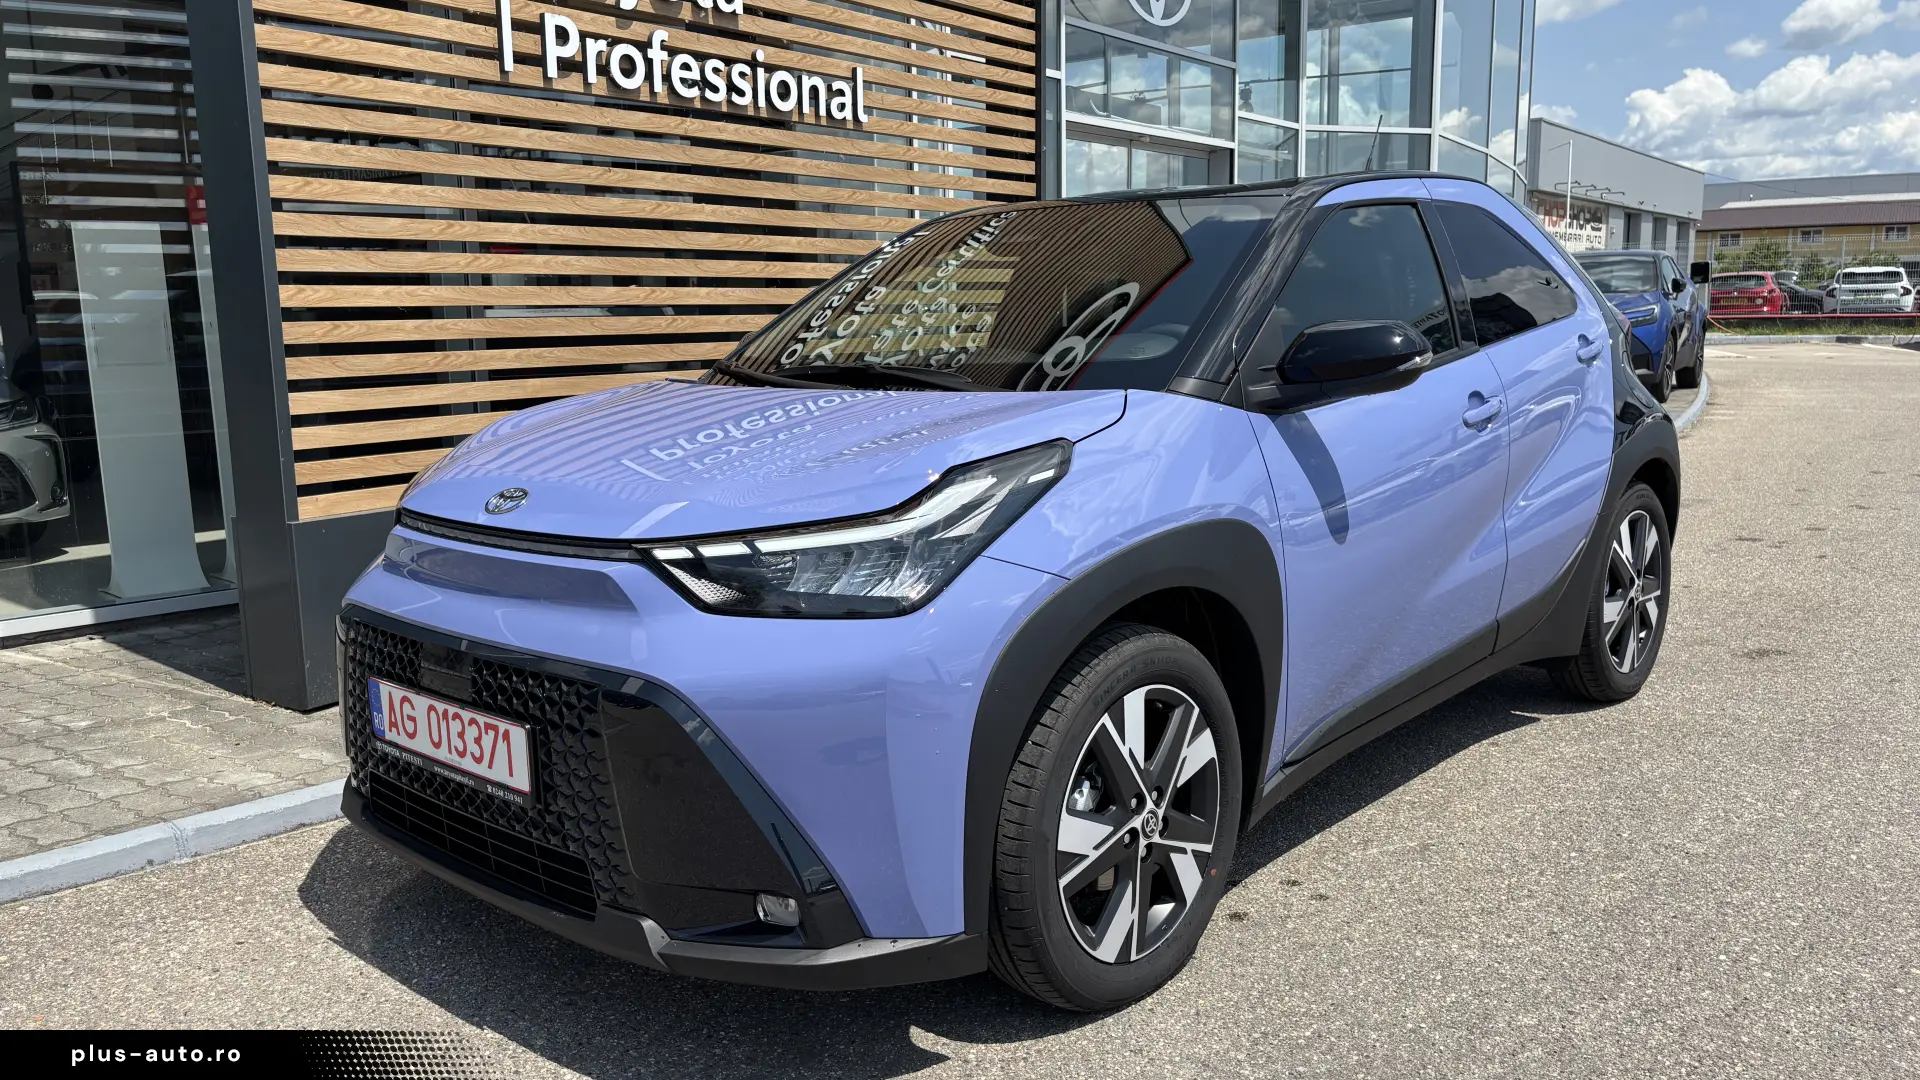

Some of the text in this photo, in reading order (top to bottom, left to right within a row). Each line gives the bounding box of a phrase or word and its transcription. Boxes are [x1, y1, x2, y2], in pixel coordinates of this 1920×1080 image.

[541, 12, 869, 123] Professional
[373, 712, 385, 731] RO
[388, 690, 514, 778] AG 013371
